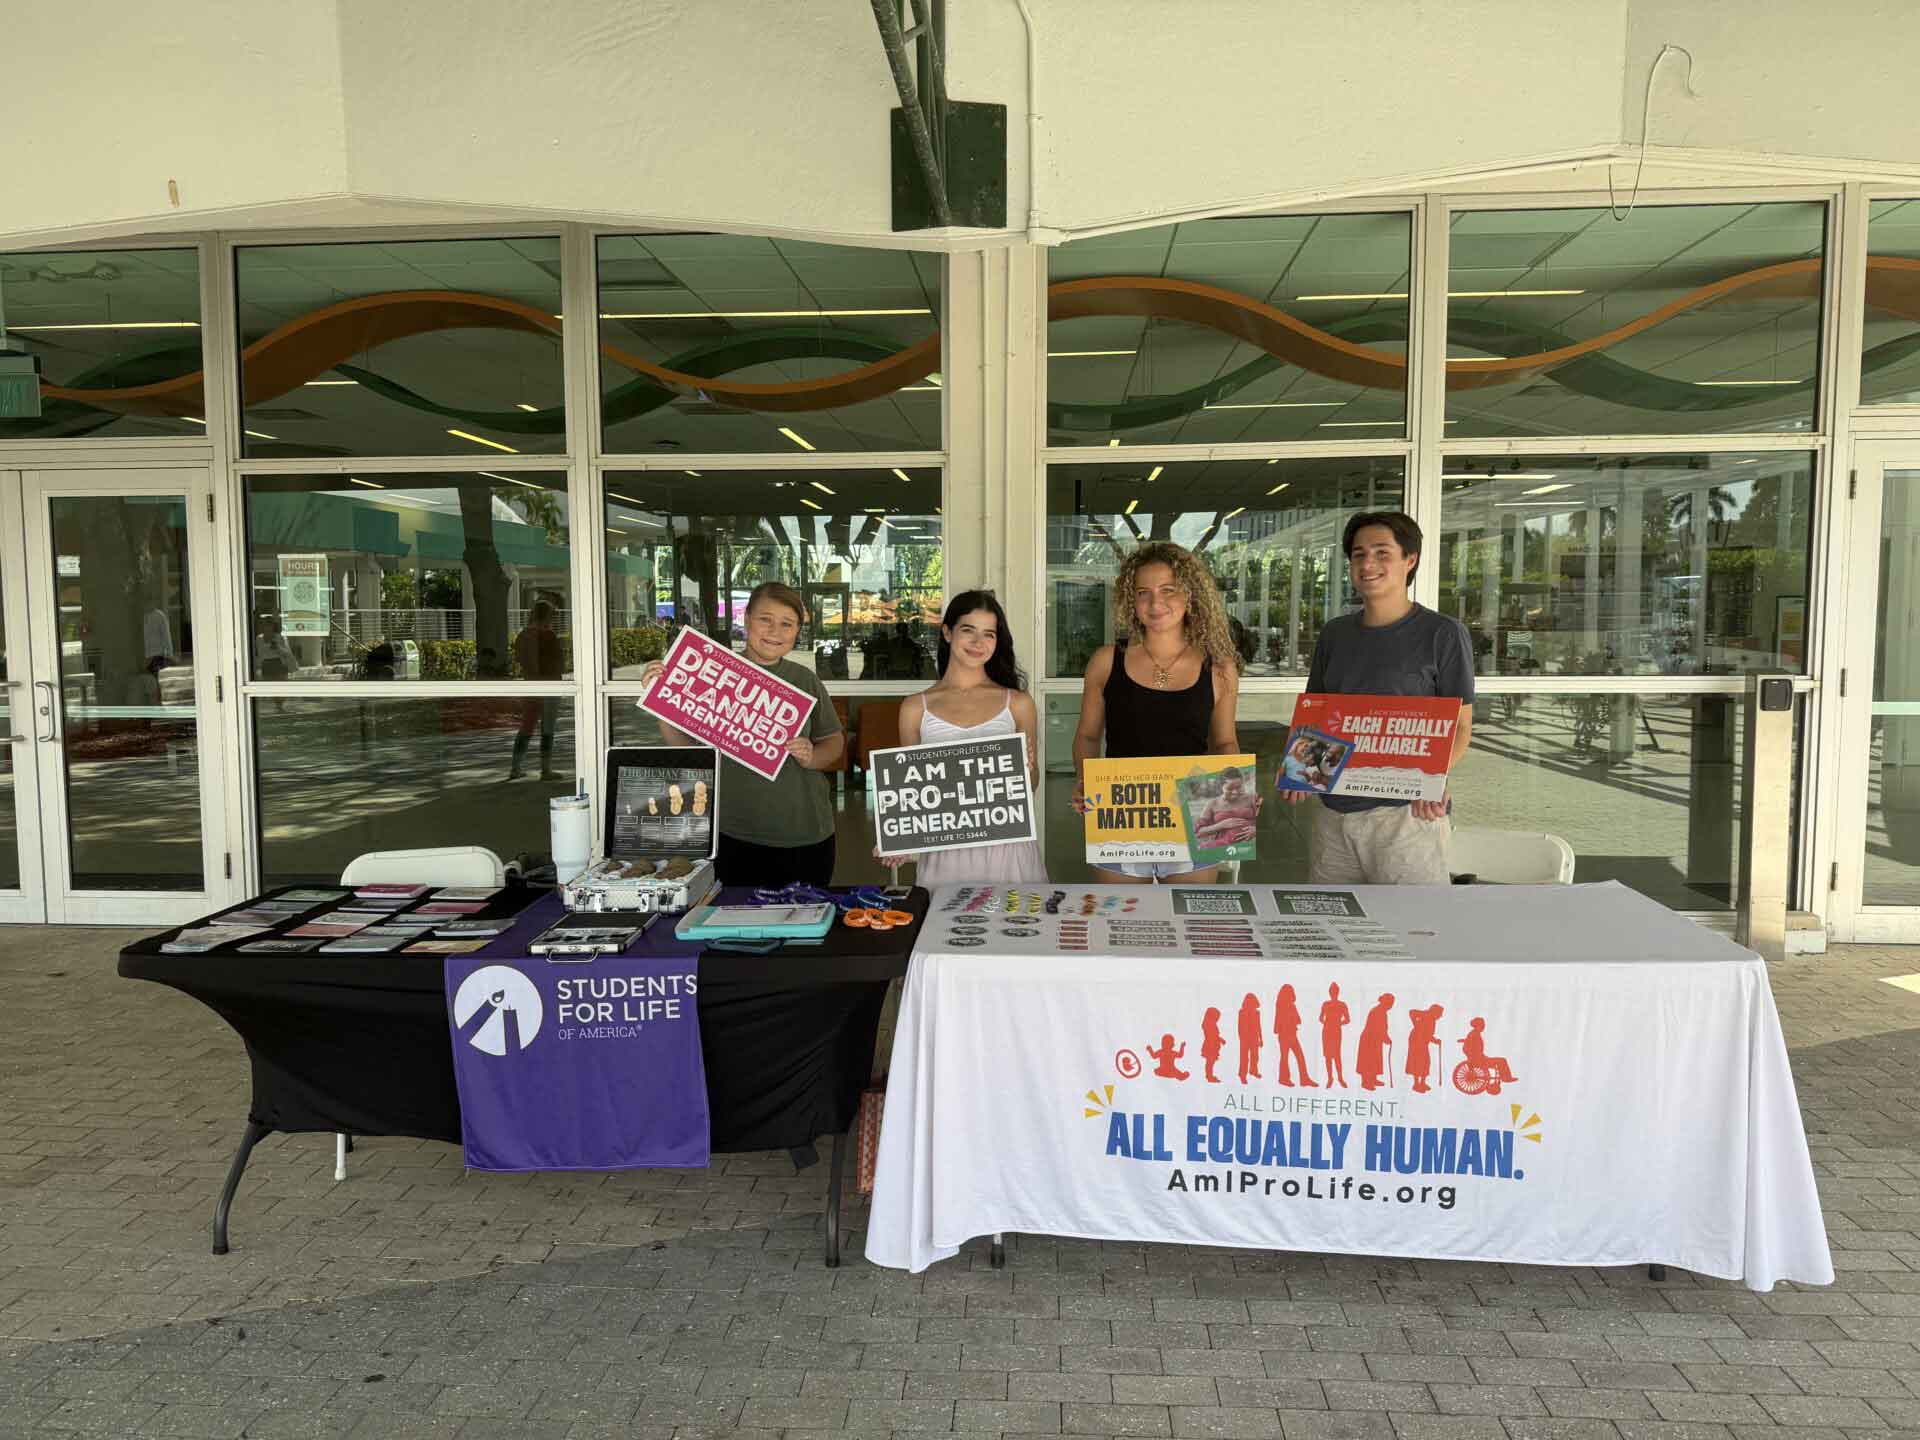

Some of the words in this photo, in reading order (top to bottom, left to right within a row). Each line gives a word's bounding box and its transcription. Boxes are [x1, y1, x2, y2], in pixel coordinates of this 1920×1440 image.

[676, 645, 800, 727] DEFUND
[665, 667, 789, 746] PLANNED
[657, 686, 779, 761] PARENTHOOD
[697, 725, 712, 738] LIFE
[1341, 716, 1384, 734] EACH
[1386, 719, 1454, 738] EQUALLY
[906, 743, 1001, 762] STUDENTSFORLIFE.ORG
[1353, 735, 1432, 757] VALUABLE.
[883, 768, 891, 786] I
[904, 762, 946, 784] AM
[959, 754, 1014, 777] THE
[878, 775, 1026, 815] PRO-LIFE
[1111, 783, 1161, 805] BOTH
[883, 804, 1025, 837] GENERATION
[1097, 807, 1177, 830] MATTER.
[940, 833, 955, 842] LIFE
[956, 832, 965, 841] TO
[966, 830, 988, 840] 53445
[1100, 849, 1176, 858] AmIProLife.org
[557, 974, 698, 1000] STUDENTS
[559, 1002, 614, 1024] FOR
[624, 998, 682, 1021] LIFE
[558, 1028, 576, 1040] OF
[1224, 1092, 1264, 1113] ALL
[1272, 1095, 1404, 1118] DIFFERENT.
[1105, 1110, 1173, 1162] ALL
[1185, 1115, 1353, 1171] EQUALLY
[1364, 1124, 1526, 1181] HUMAN.
[1167, 1168, 1458, 1210] AmIProLife.org
